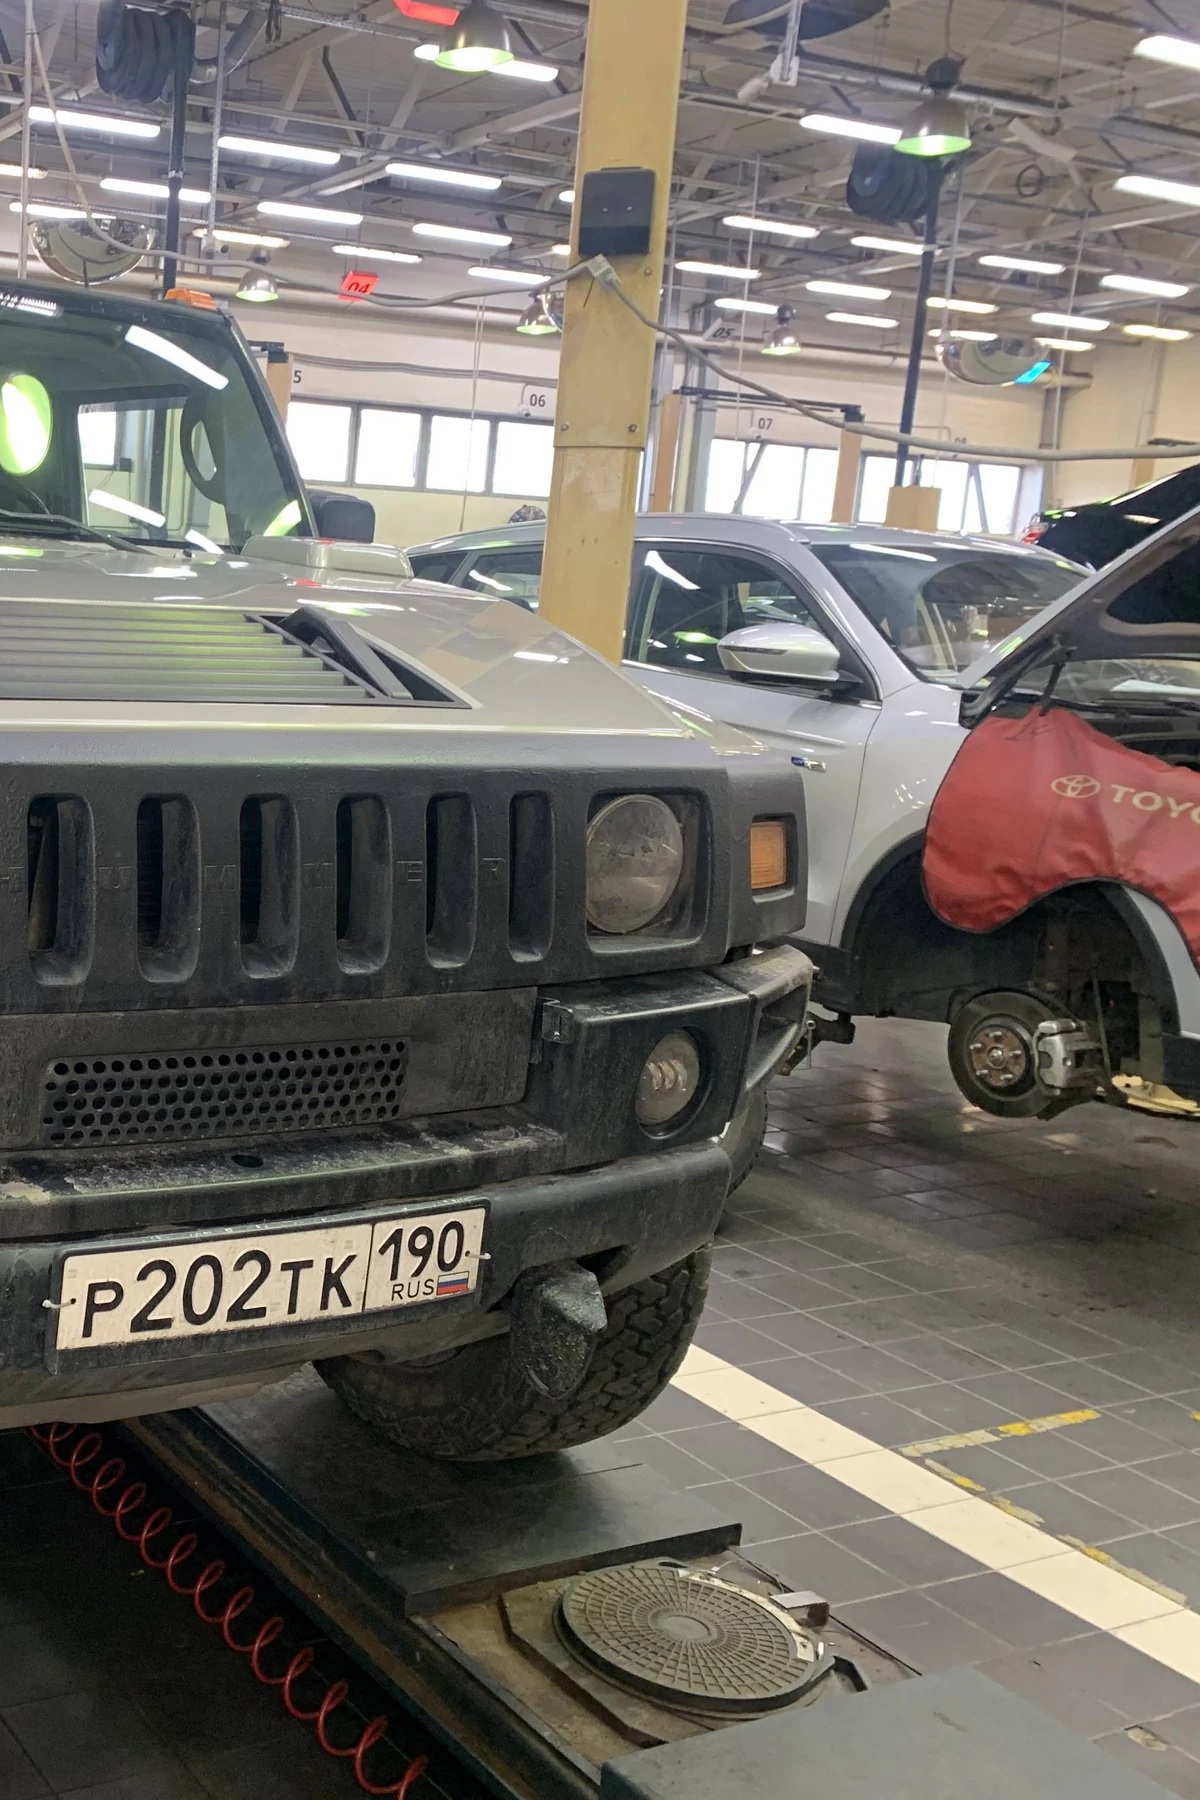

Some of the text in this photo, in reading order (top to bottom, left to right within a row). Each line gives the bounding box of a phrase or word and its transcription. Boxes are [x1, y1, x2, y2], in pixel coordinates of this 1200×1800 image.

[712, 327, 735, 338] 05
[530, 393, 546, 407] 06
[758, 417, 773, 430] 07
[378, 1220, 465, 1281] 190
[391, 1278, 435, 1302] RUS
